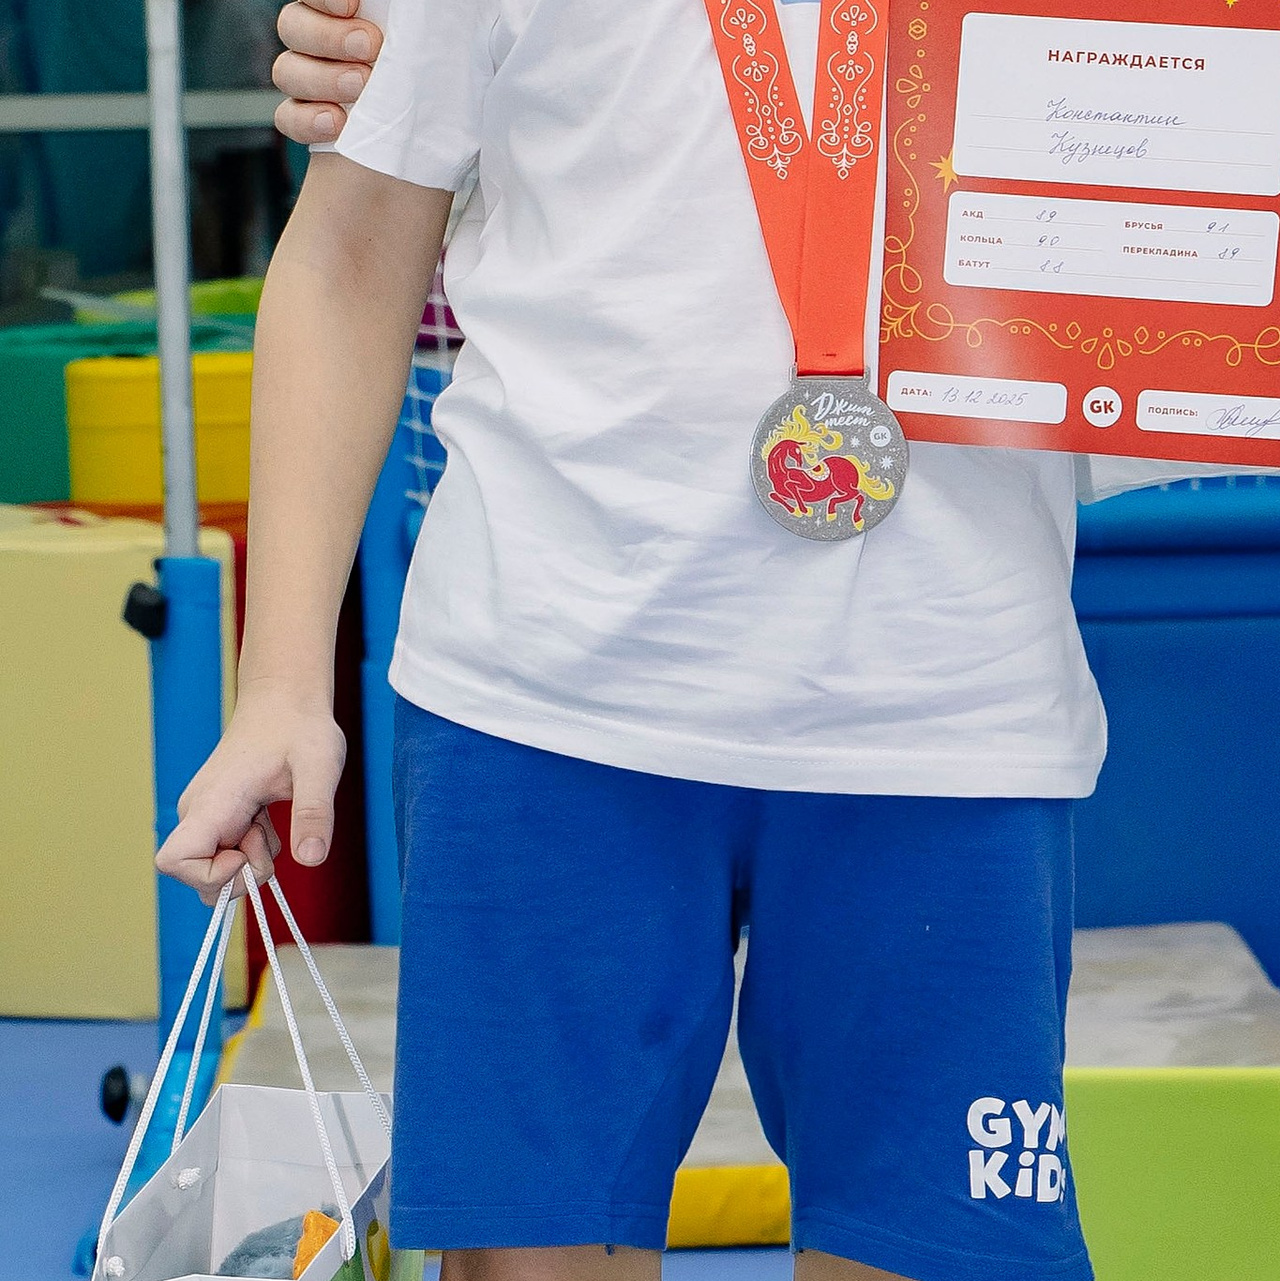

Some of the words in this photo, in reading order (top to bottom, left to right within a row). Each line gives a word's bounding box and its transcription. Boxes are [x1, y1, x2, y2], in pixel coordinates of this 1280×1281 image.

[1048, 49, 1206, 71] НАГРАЖДАЕТСЯ
[1046, 97, 1187, 126] Константин
[961, 210, 984, 219] АКД
[1124, 221, 1164, 230] БРУСЬЯ
[960, 235, 1003, 245] КОЛЬЦА
[1122, 246, 1199, 258] ПЕРЕКЛАДИНА
[958, 259, 991, 269] БАТУТ
[900, 387, 932, 396] ДАТА:
[1089, 399, 1115, 415] GK
[1148, 406, 1198, 417] ПОДПИСЬ:
[873, 432, 887, 440] GK
